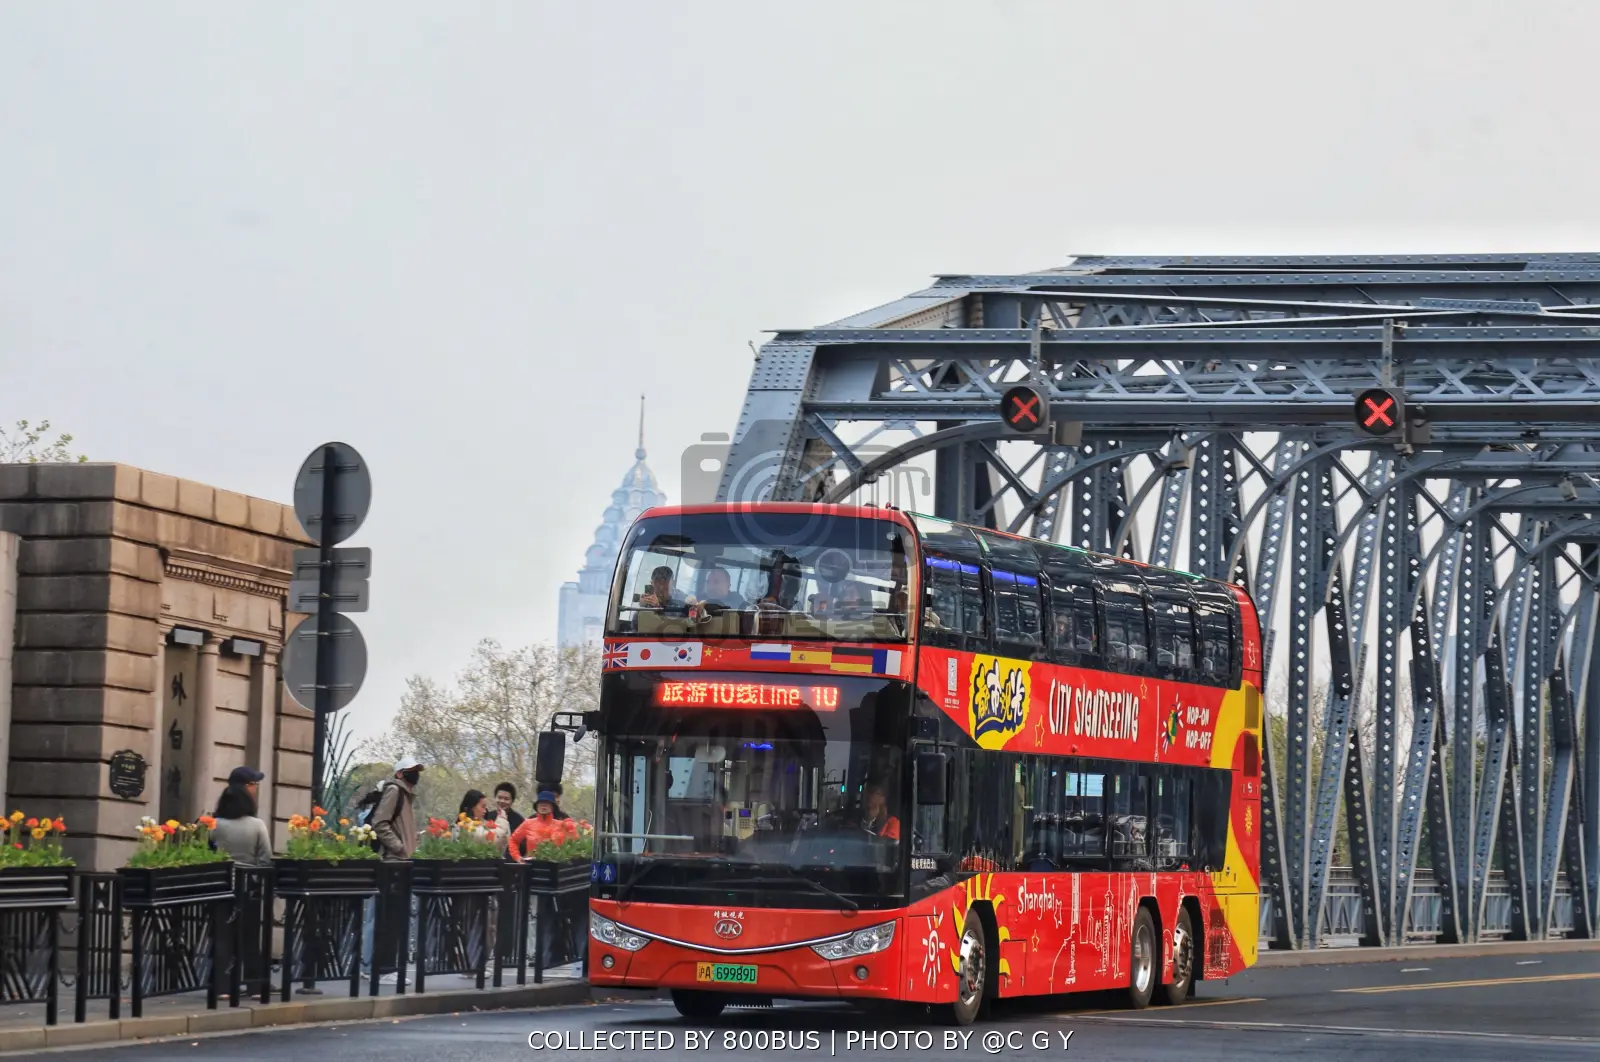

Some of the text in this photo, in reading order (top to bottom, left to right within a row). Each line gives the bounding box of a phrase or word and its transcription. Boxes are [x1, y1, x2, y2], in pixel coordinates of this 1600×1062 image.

[811, 686, 838, 707] 10
[1049, 678, 1139, 742] CITY SIGHTSEEING
[1186, 706, 1210, 726] HOP-ON
[1185, 730, 1212, 750] HOP-OFF
[1018, 877, 1055, 921] Shanghai
[716, 966, 756, 982] 69989D
